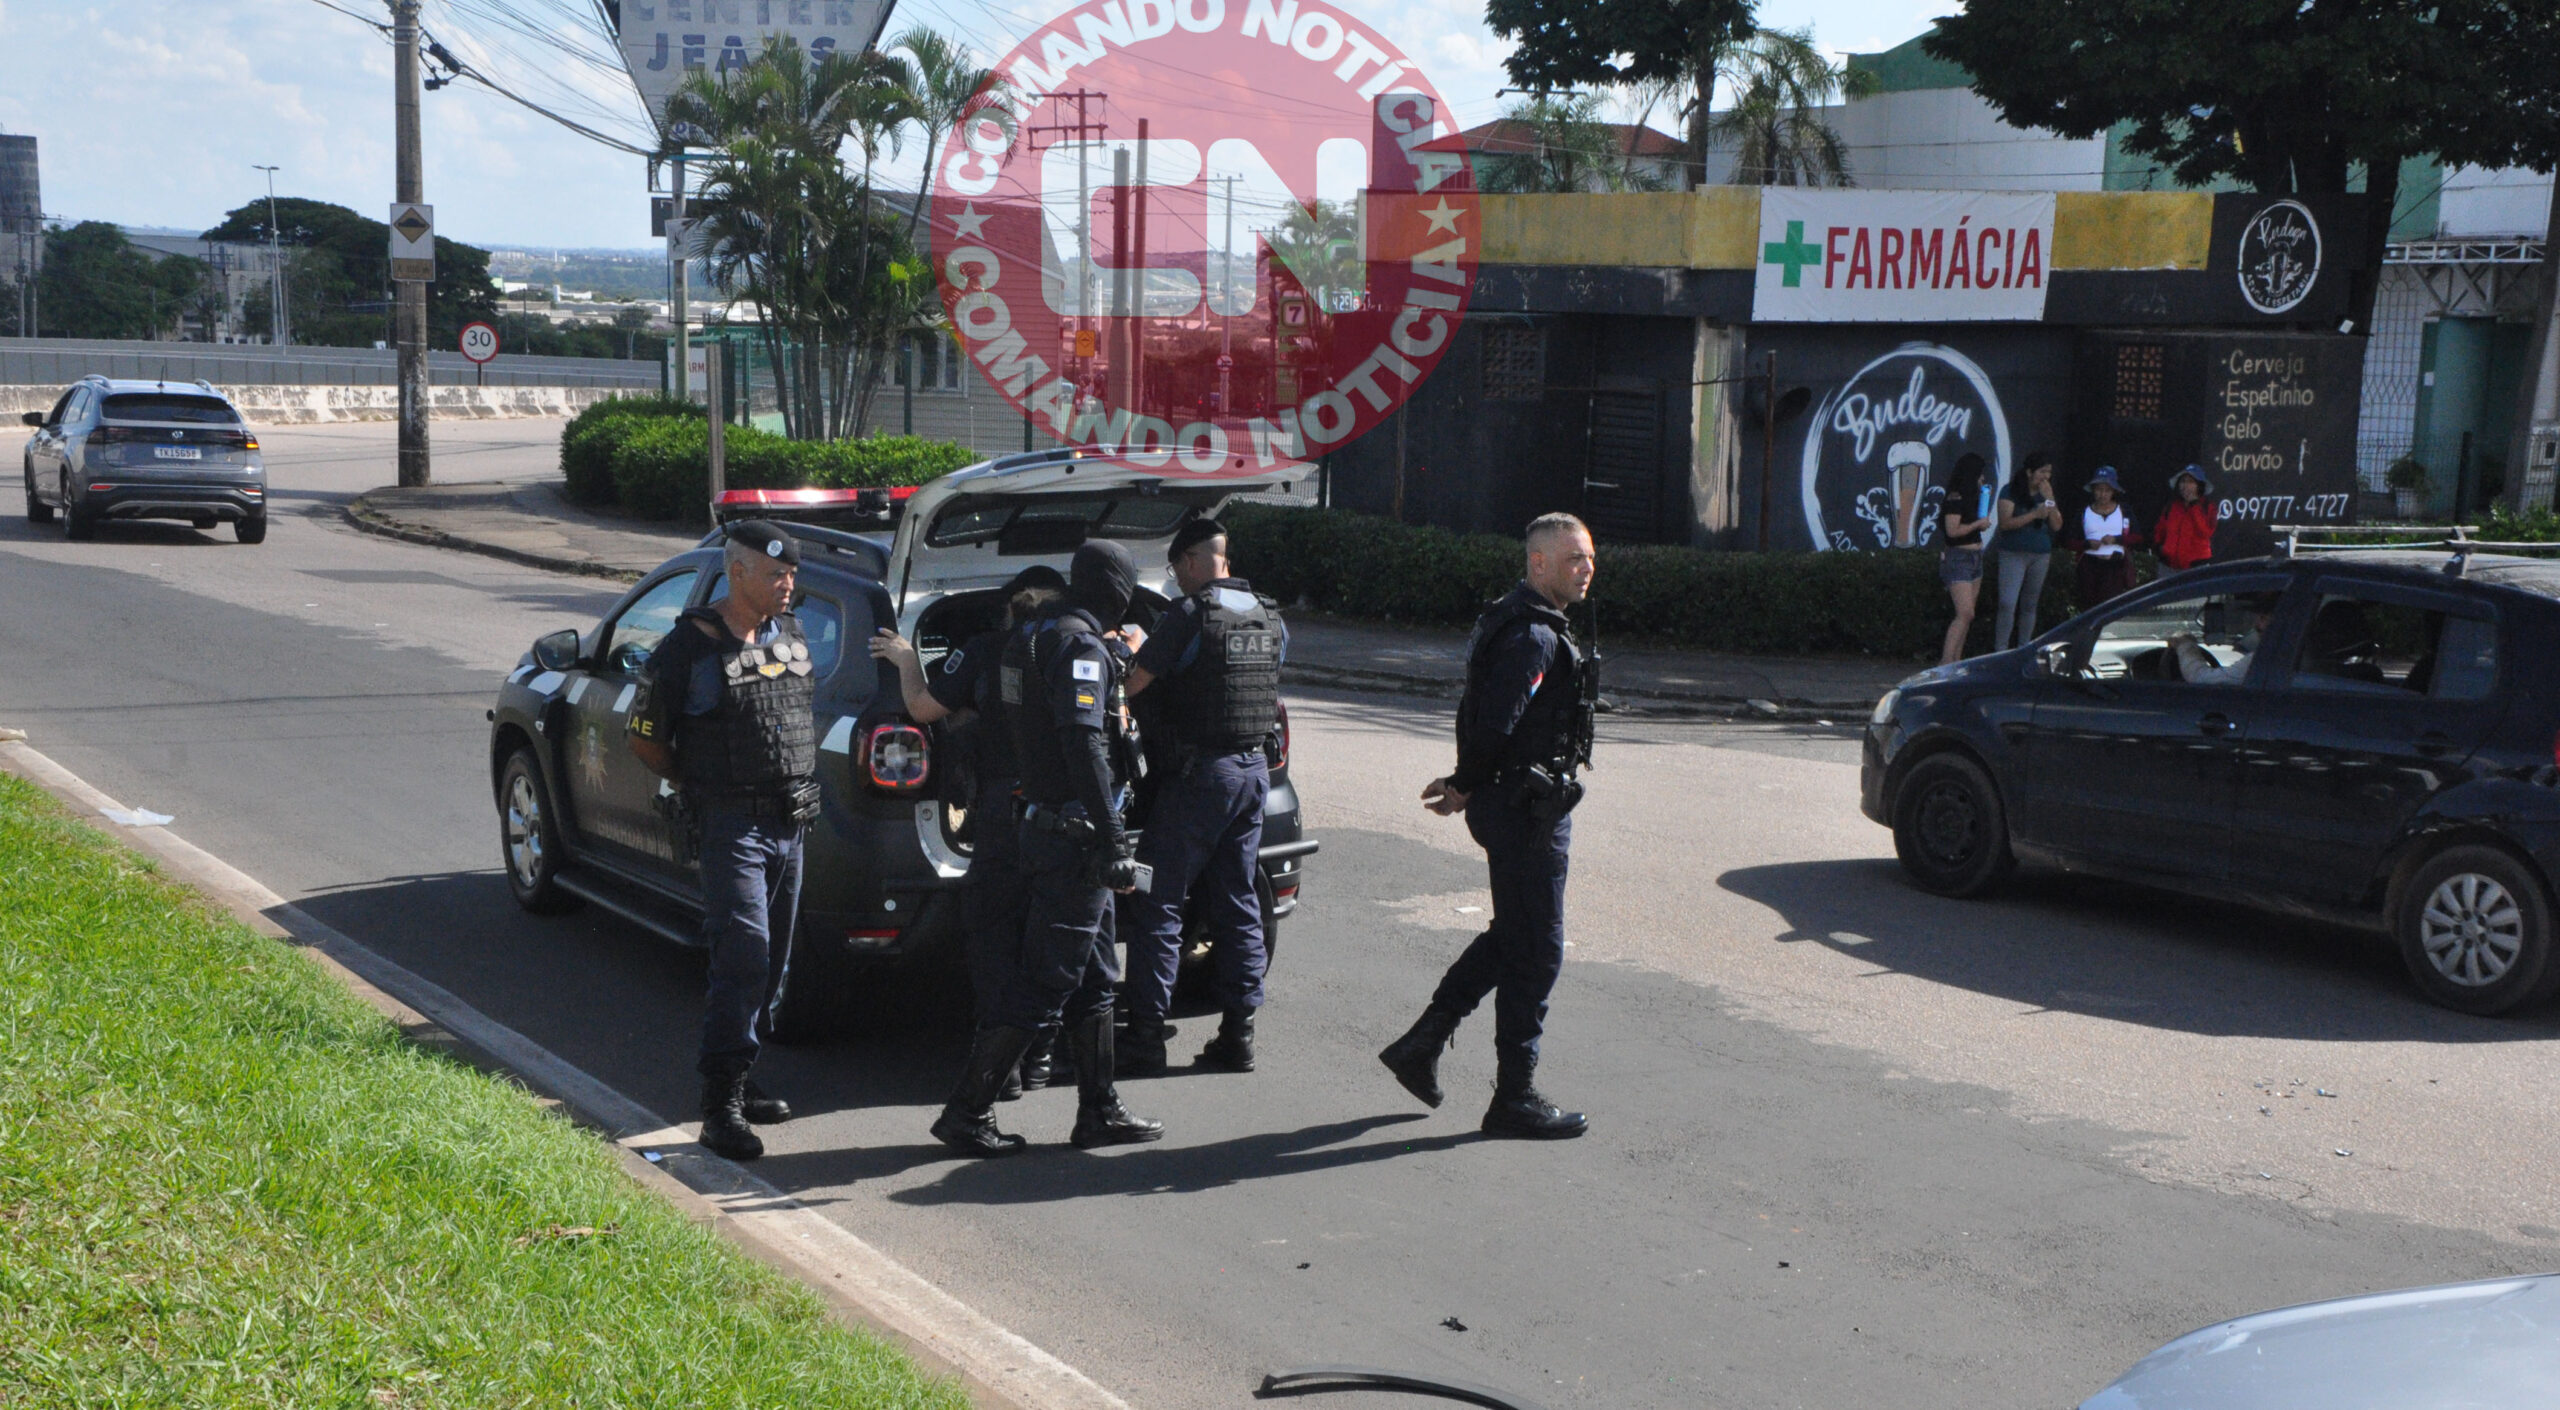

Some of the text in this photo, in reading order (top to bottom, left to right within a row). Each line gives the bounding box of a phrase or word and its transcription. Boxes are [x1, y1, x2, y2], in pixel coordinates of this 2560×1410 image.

[646, 32, 836, 73] JEAS
[1825, 215, 2042, 289] FARMÁCIA
[468, 330, 491, 347] 30
[2229, 350, 2304, 383] Cerveja
[1834, 366, 1971, 463] Budega
[2225, 380, 2314, 416] Espetinho
[2223, 413, 2261, 440] Gelo
[2221, 445, 2283, 471] Carvão
[1229, 635, 1272, 652] GAE
